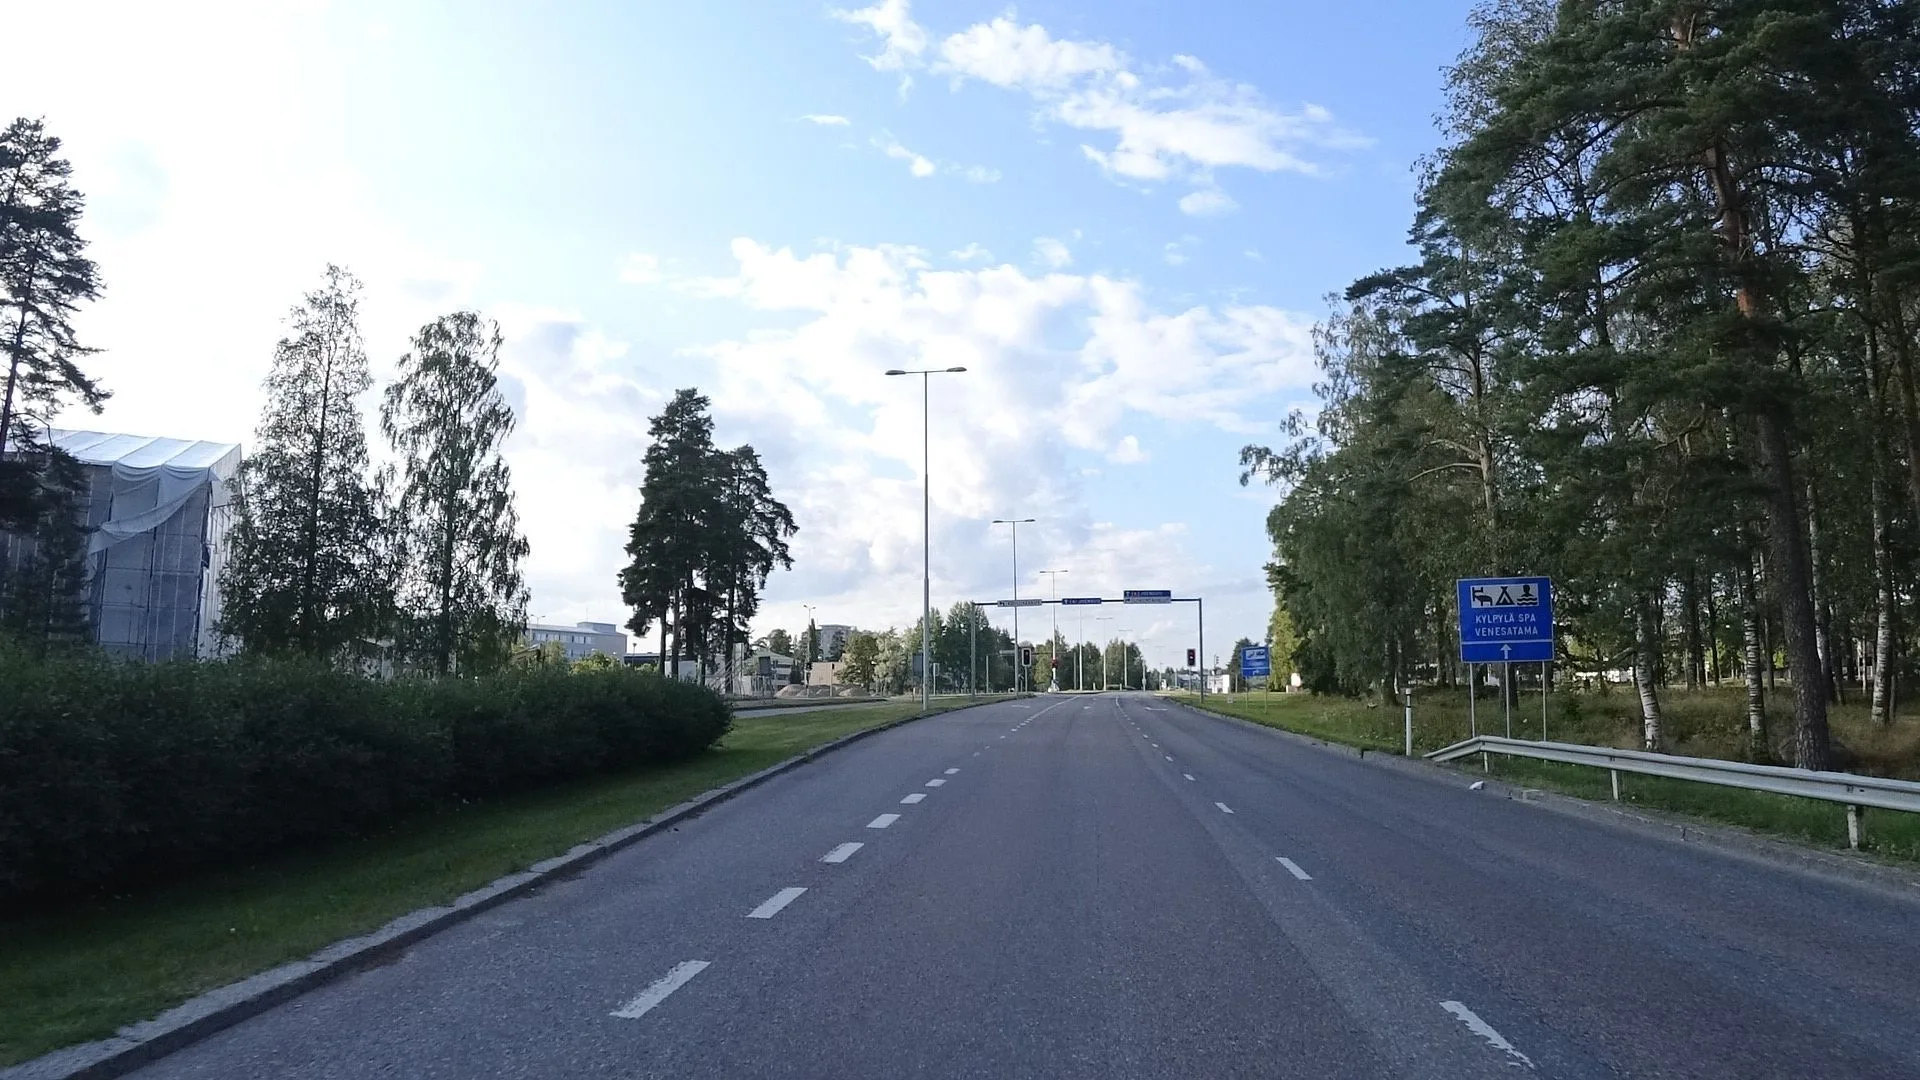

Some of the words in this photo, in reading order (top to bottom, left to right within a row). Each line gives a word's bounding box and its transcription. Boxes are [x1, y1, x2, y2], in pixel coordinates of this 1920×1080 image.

[1475, 613, 1515, 624] KYLPYLÄ
[1518, 613, 1536, 623] SPA
[1474, 626, 1538, 637] VENESATAMA
